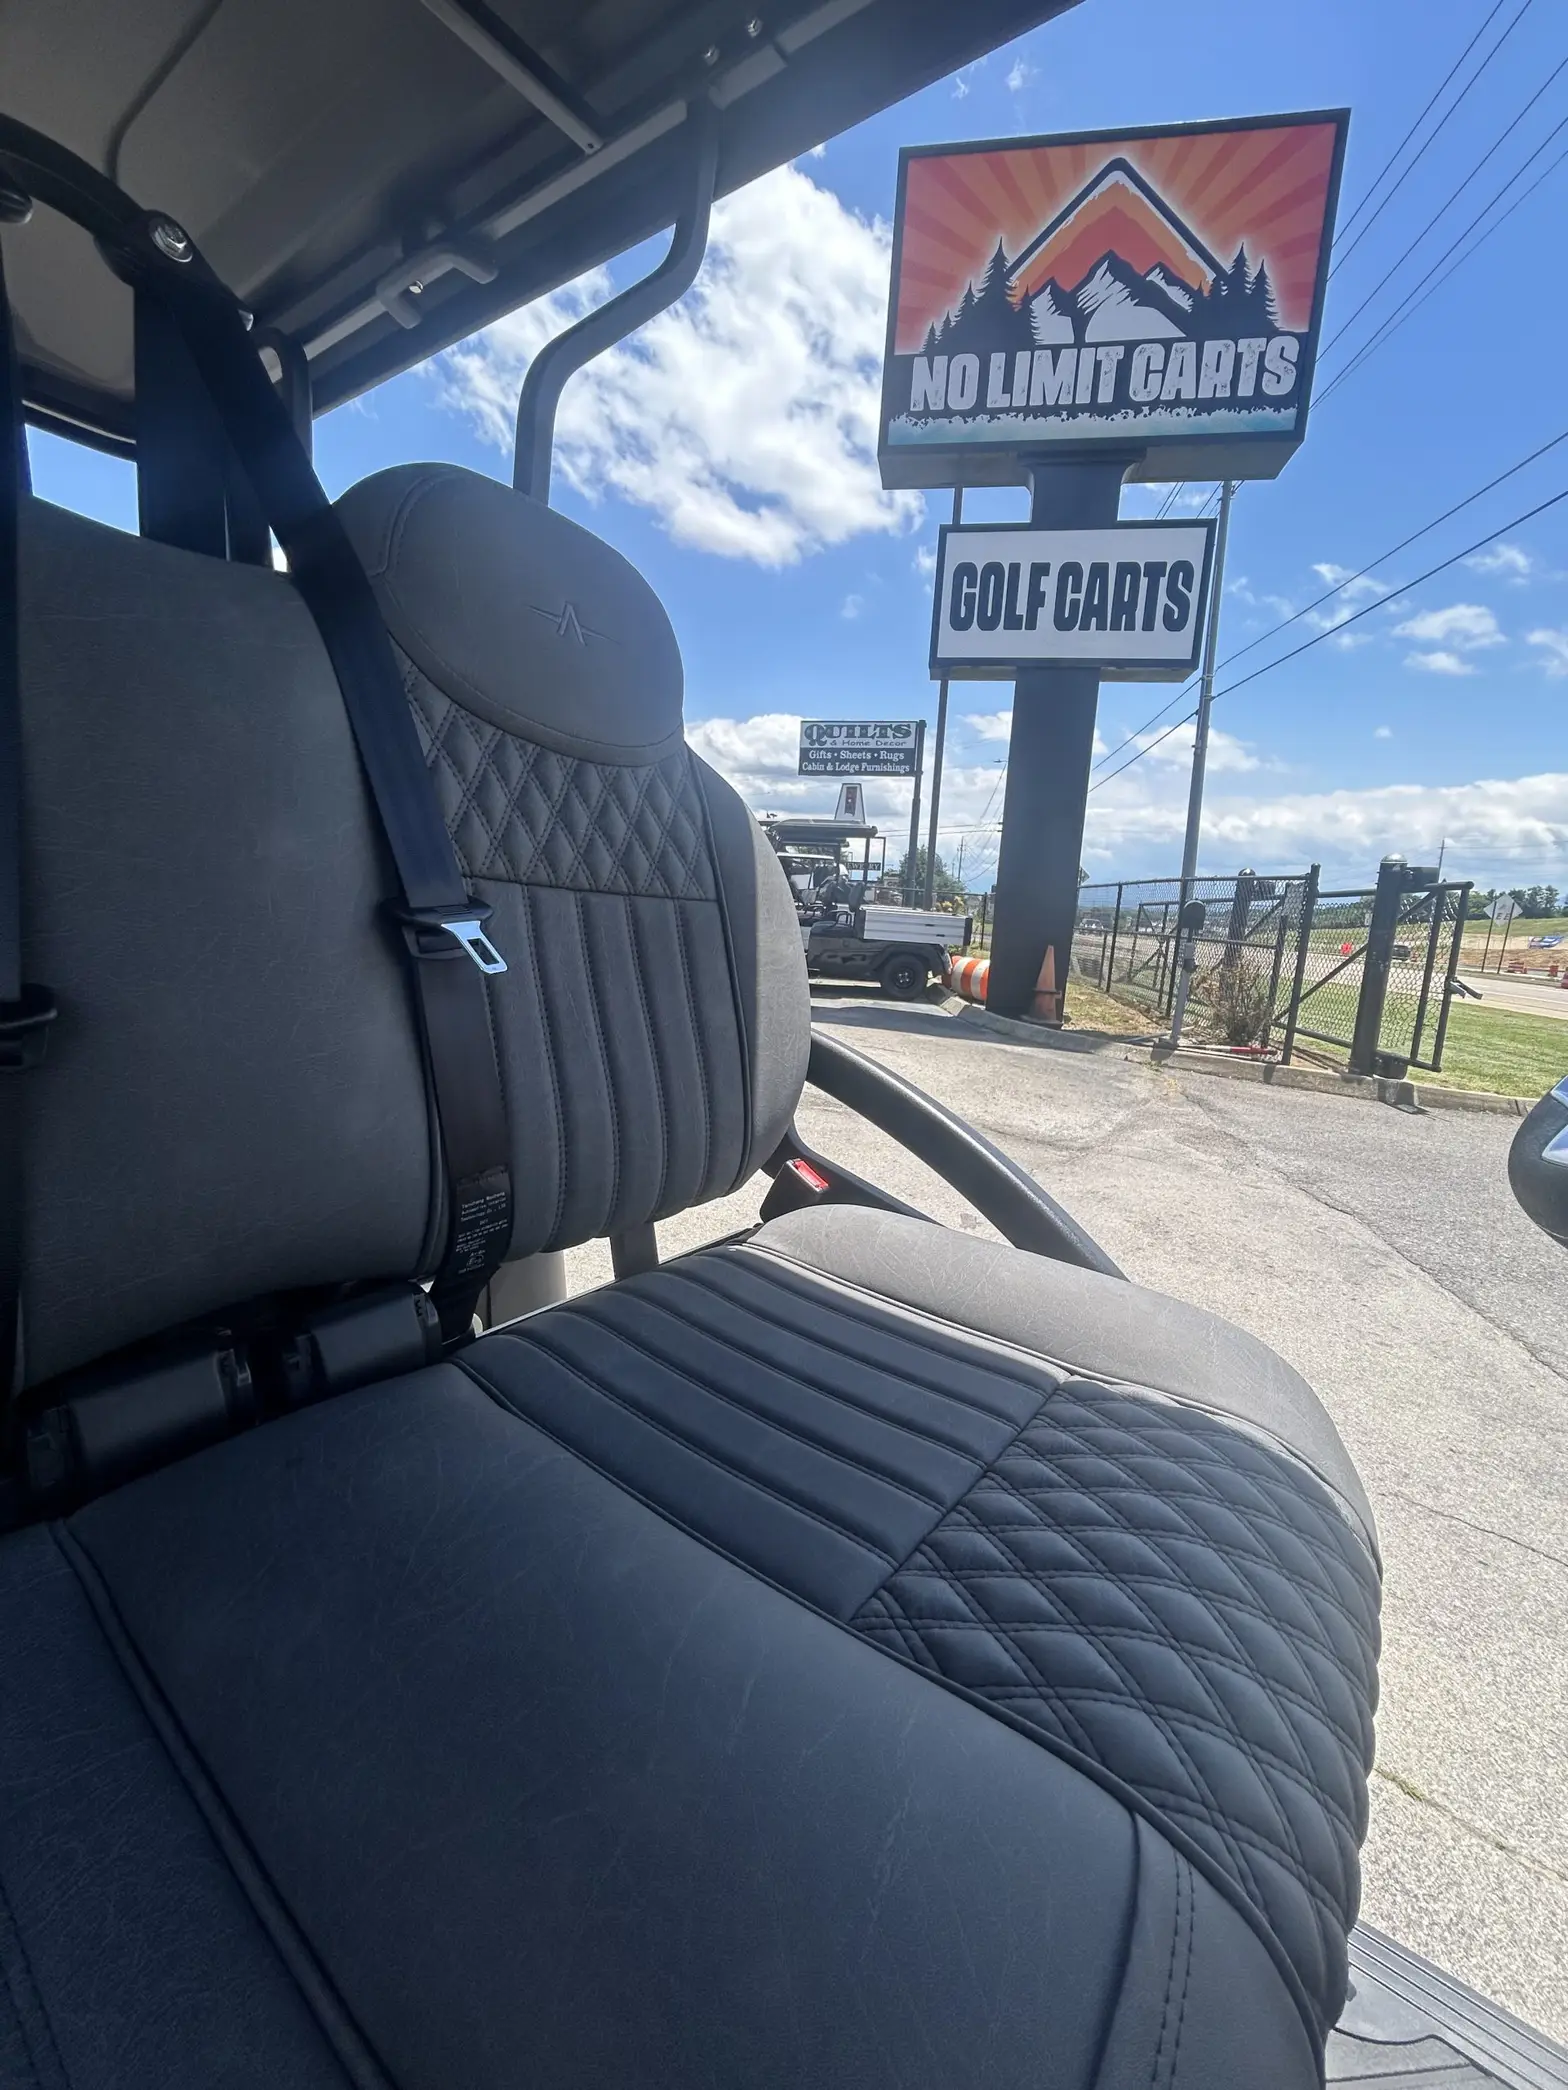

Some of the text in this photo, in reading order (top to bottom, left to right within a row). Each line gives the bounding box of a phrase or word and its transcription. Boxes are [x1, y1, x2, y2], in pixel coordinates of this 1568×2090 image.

[909, 335, 1299, 412] NO LIMIT CARTS
[949, 559, 1195, 632] GOLF CARTS
[804, 723, 912, 747] QUILTS
[802, 762, 910, 774] Cabin & Lodge Furnishings
[809, 750, 905, 762] Gifts Sheets Rugs
